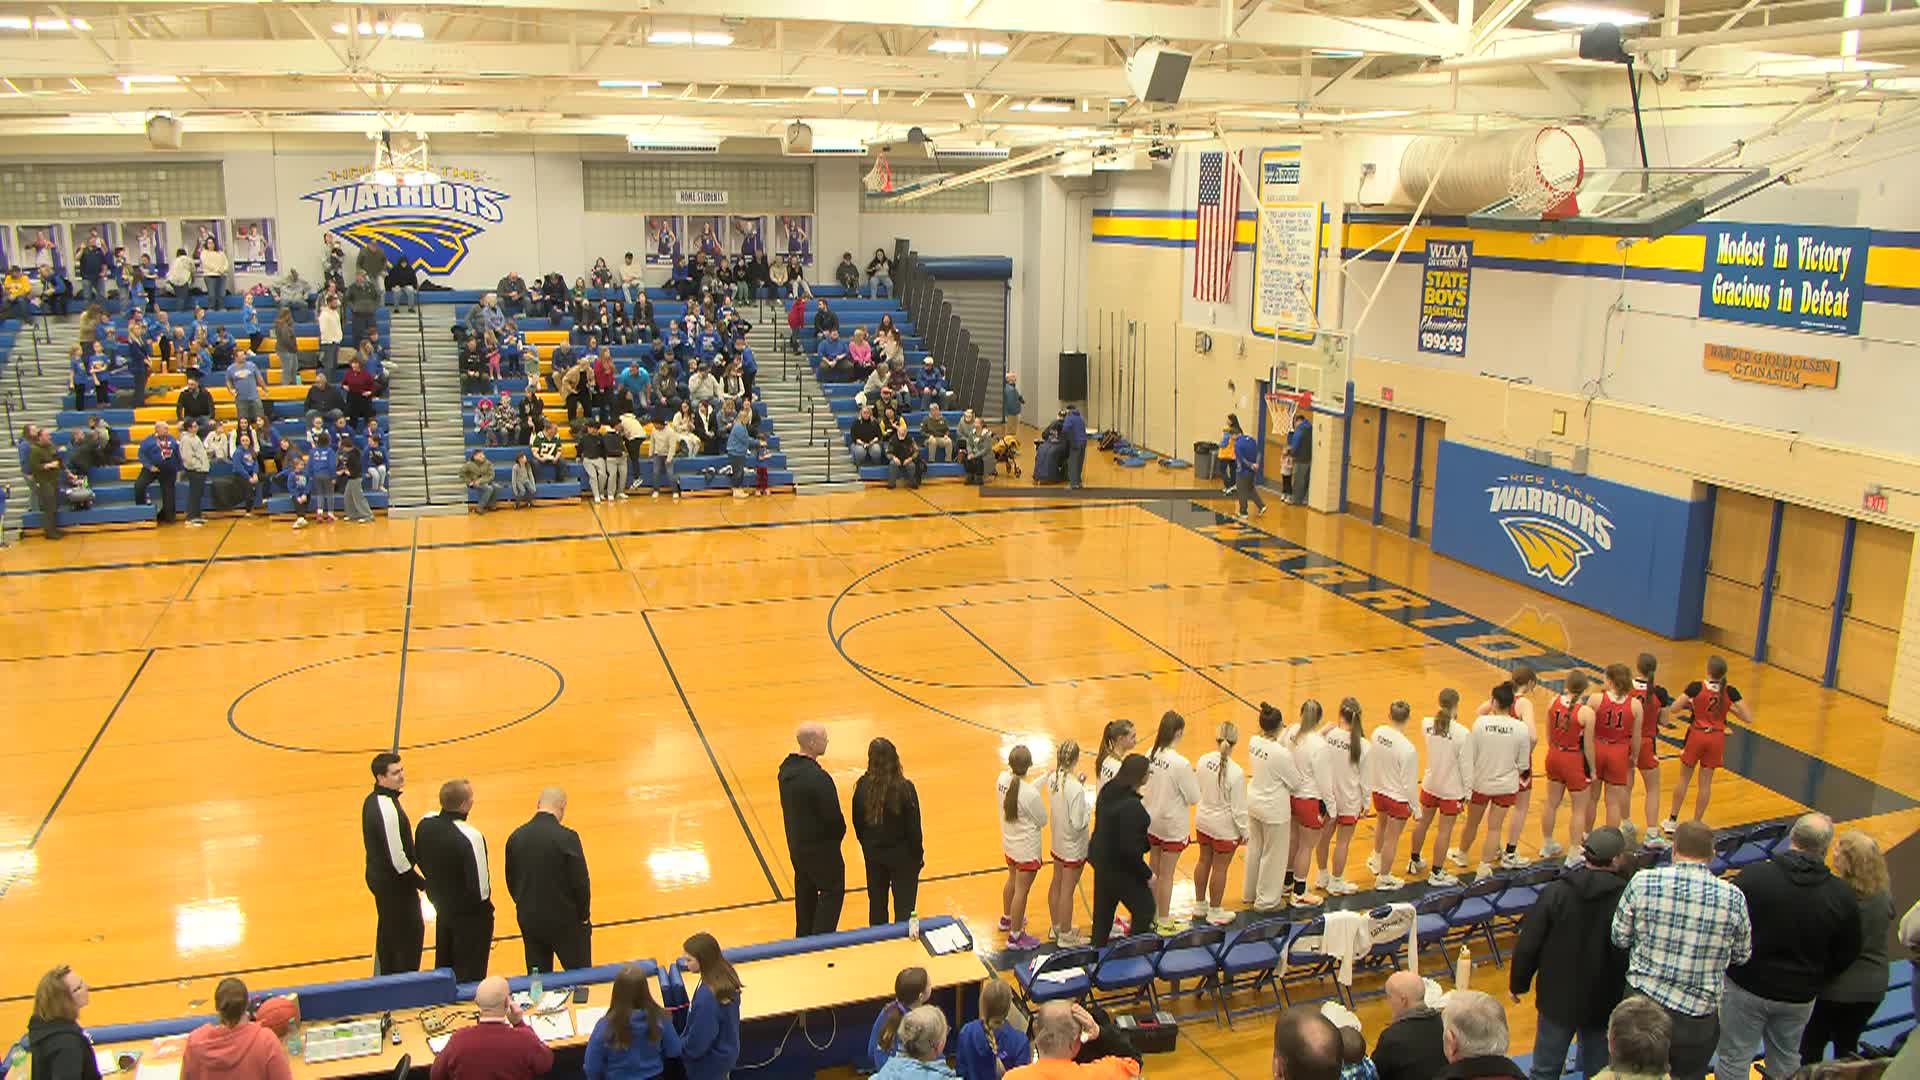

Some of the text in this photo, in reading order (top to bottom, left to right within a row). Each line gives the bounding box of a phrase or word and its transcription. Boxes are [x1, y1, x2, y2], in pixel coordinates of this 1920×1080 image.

[63, 195, 120, 206] VISITOR STUDENTS
[301, 182, 510, 224] WARRIORS
[681, 191, 724, 202] HOME STUDENTS
[1429, 242, 1468, 258] WIAA
[1716, 231, 1851, 281] Modest in Victory
[1428, 257, 1459, 269] DIVISION
[1425, 271, 1468, 289] STATE
[1424, 287, 1467, 308] BOYS
[1712, 272, 1849, 318] Gracious in Defeat
[1423, 305, 1465, 319] BASKETBALL
[1421, 332, 1464, 352] 1992-93
[1710, 345, 1751, 363] HAROLD
[1794, 358, 1832, 373] OLSEN
[1734, 362, 1800, 384] GYMNASIUM
[540, 443, 557, 459] 27
[1510, 473, 1596, 503] RICE LAKE
[1484, 485, 1616, 551] WARRIORS
[1605, 708, 1624, 729] 11
